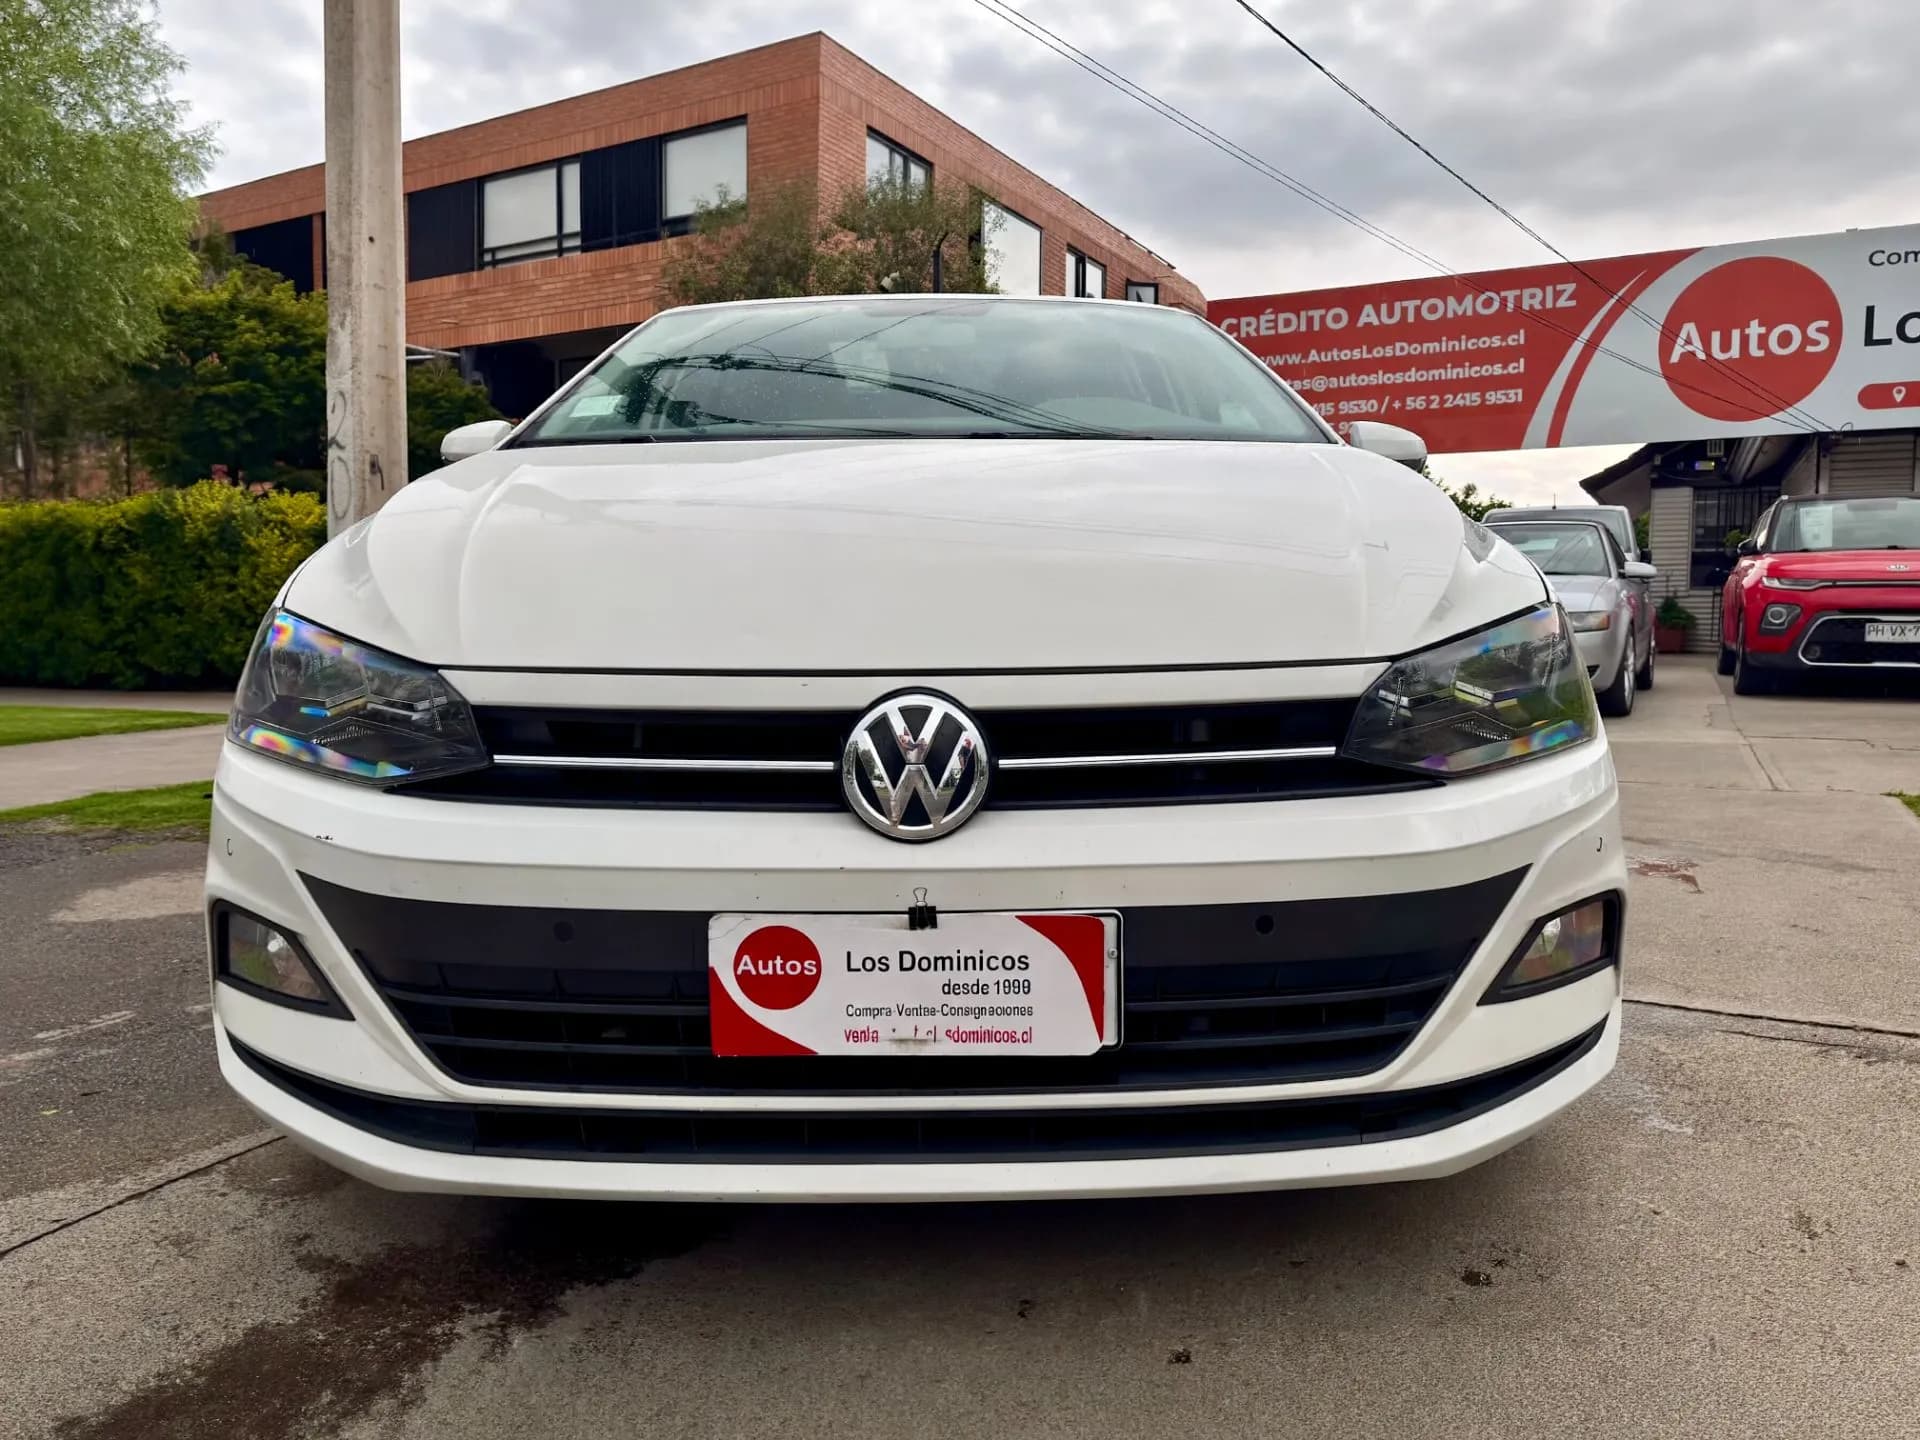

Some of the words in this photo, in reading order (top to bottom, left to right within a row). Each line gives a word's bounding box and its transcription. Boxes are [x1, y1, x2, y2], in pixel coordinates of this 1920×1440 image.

[1220, 307, 1349, 338] CRÉDITO
[1356, 282, 1577, 327] AUTOMOTRIZ
[1864, 304, 1920, 347] Lo
[1669, 318, 1831, 364] Autos
[1338, 398, 1379, 414] 9530
[1405, 395, 1427, 411] 56
[1429, 395, 1440, 409] 2
[1443, 392, 1481, 409] 2415
[1485, 388, 1523, 406] 9531
[736, 954, 817, 976] Autos
[846, 950, 890, 972] Los
[898, 949, 1030, 972] Dominicos
[942, 977, 990, 996] desde
